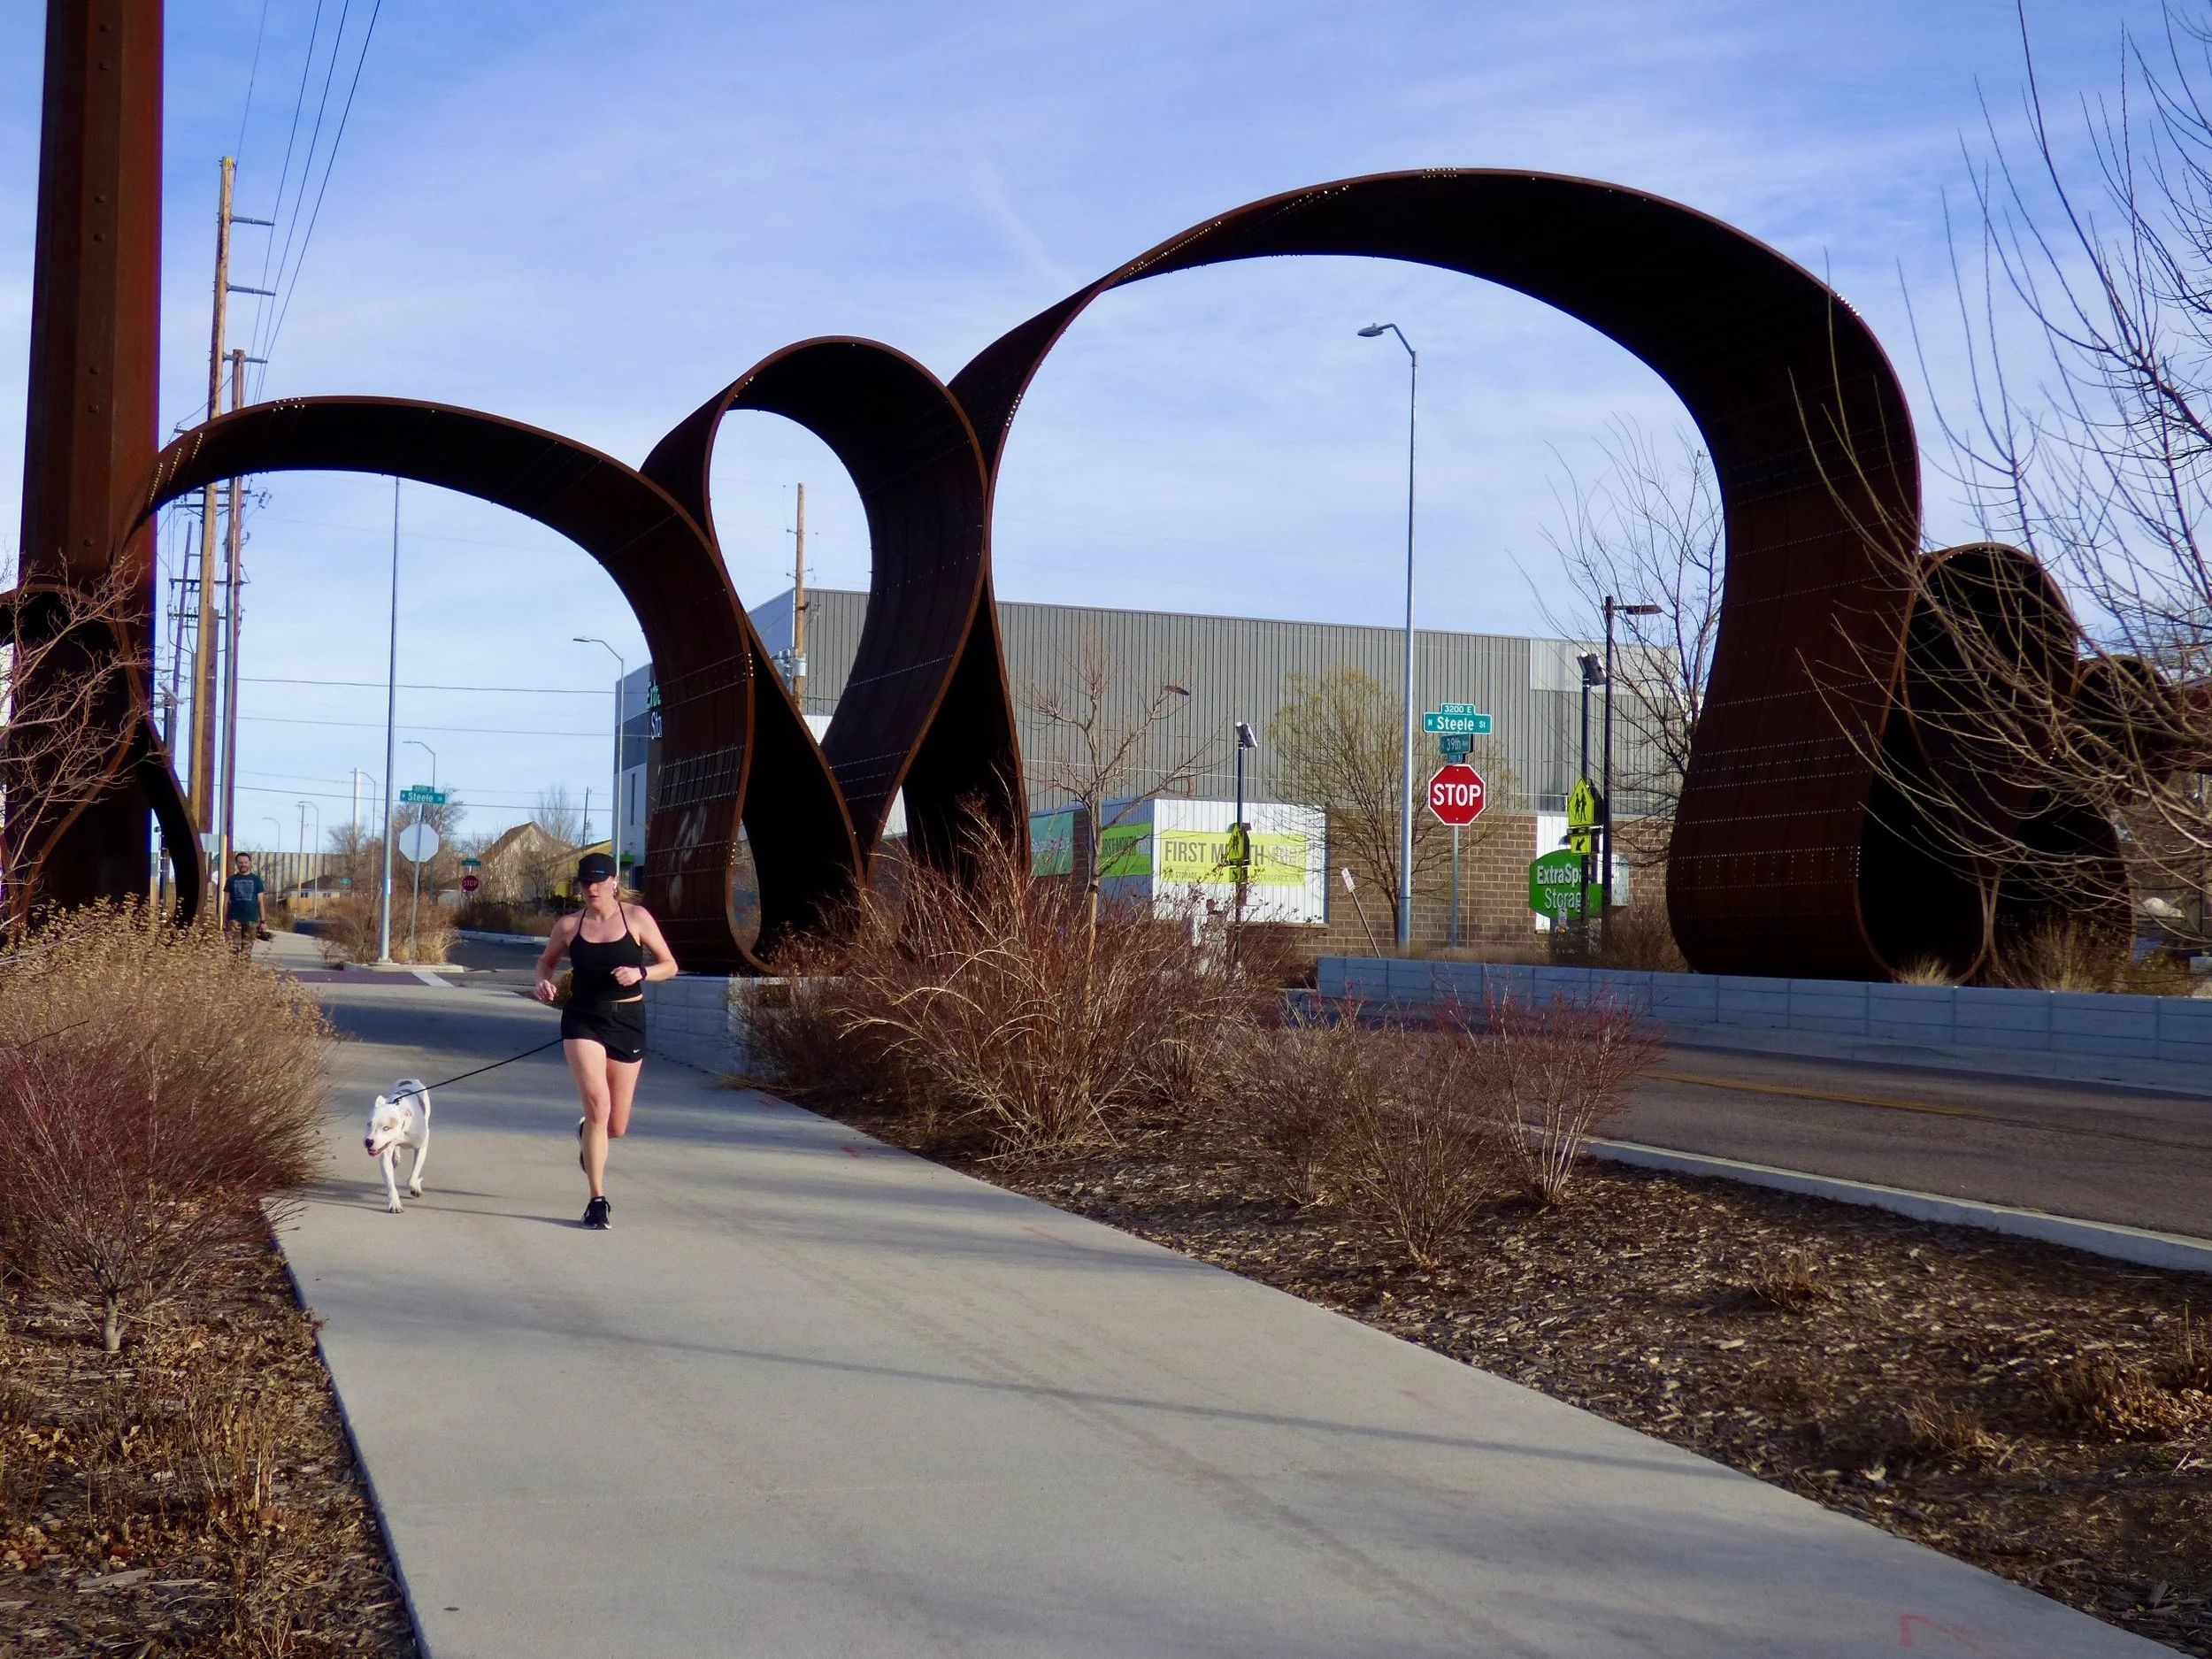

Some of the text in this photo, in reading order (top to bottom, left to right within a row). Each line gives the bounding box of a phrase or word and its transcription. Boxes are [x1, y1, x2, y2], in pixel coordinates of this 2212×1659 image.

[1437, 716, 1474, 731] Steele
[1446, 738, 1462, 751] 39th
[408, 793, 434, 803] Steele
[1432, 783, 1482, 807] STOP
[1164, 841, 1207, 863] FIRST
[1210, 842, 1264, 864] MTH
[1537, 863, 1582, 888] ExtraSp
[1545, 887, 1586, 913] Storag
